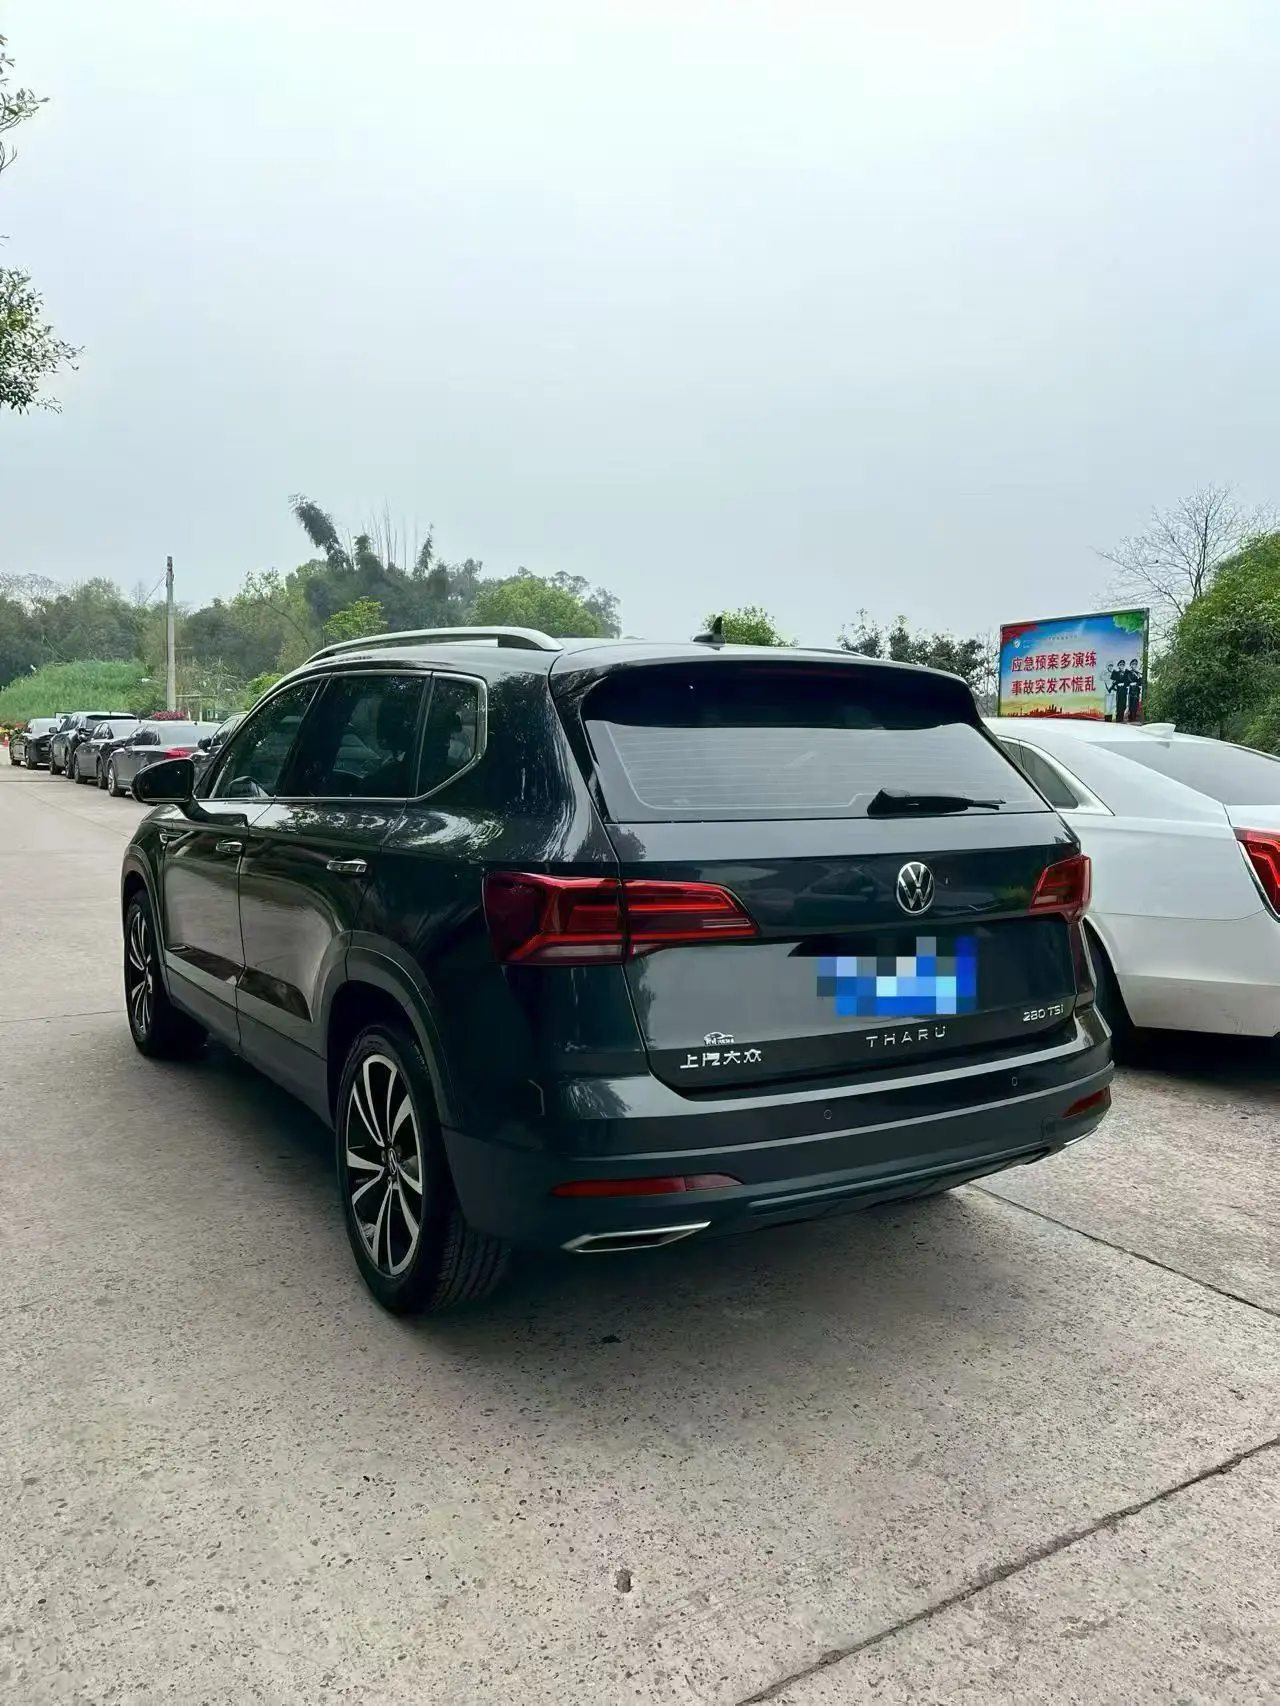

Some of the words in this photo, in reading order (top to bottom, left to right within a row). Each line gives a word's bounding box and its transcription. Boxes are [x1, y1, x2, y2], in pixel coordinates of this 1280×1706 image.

[1011, 651, 1097, 673] 应急预案多演练
[1011, 676, 1096, 696] 事故突发不慌乱
[1022, 1008, 1046, 1022] 280
[866, 1025, 947, 1048] THARU
[680, 1048, 762, 1069] 上汽大众
